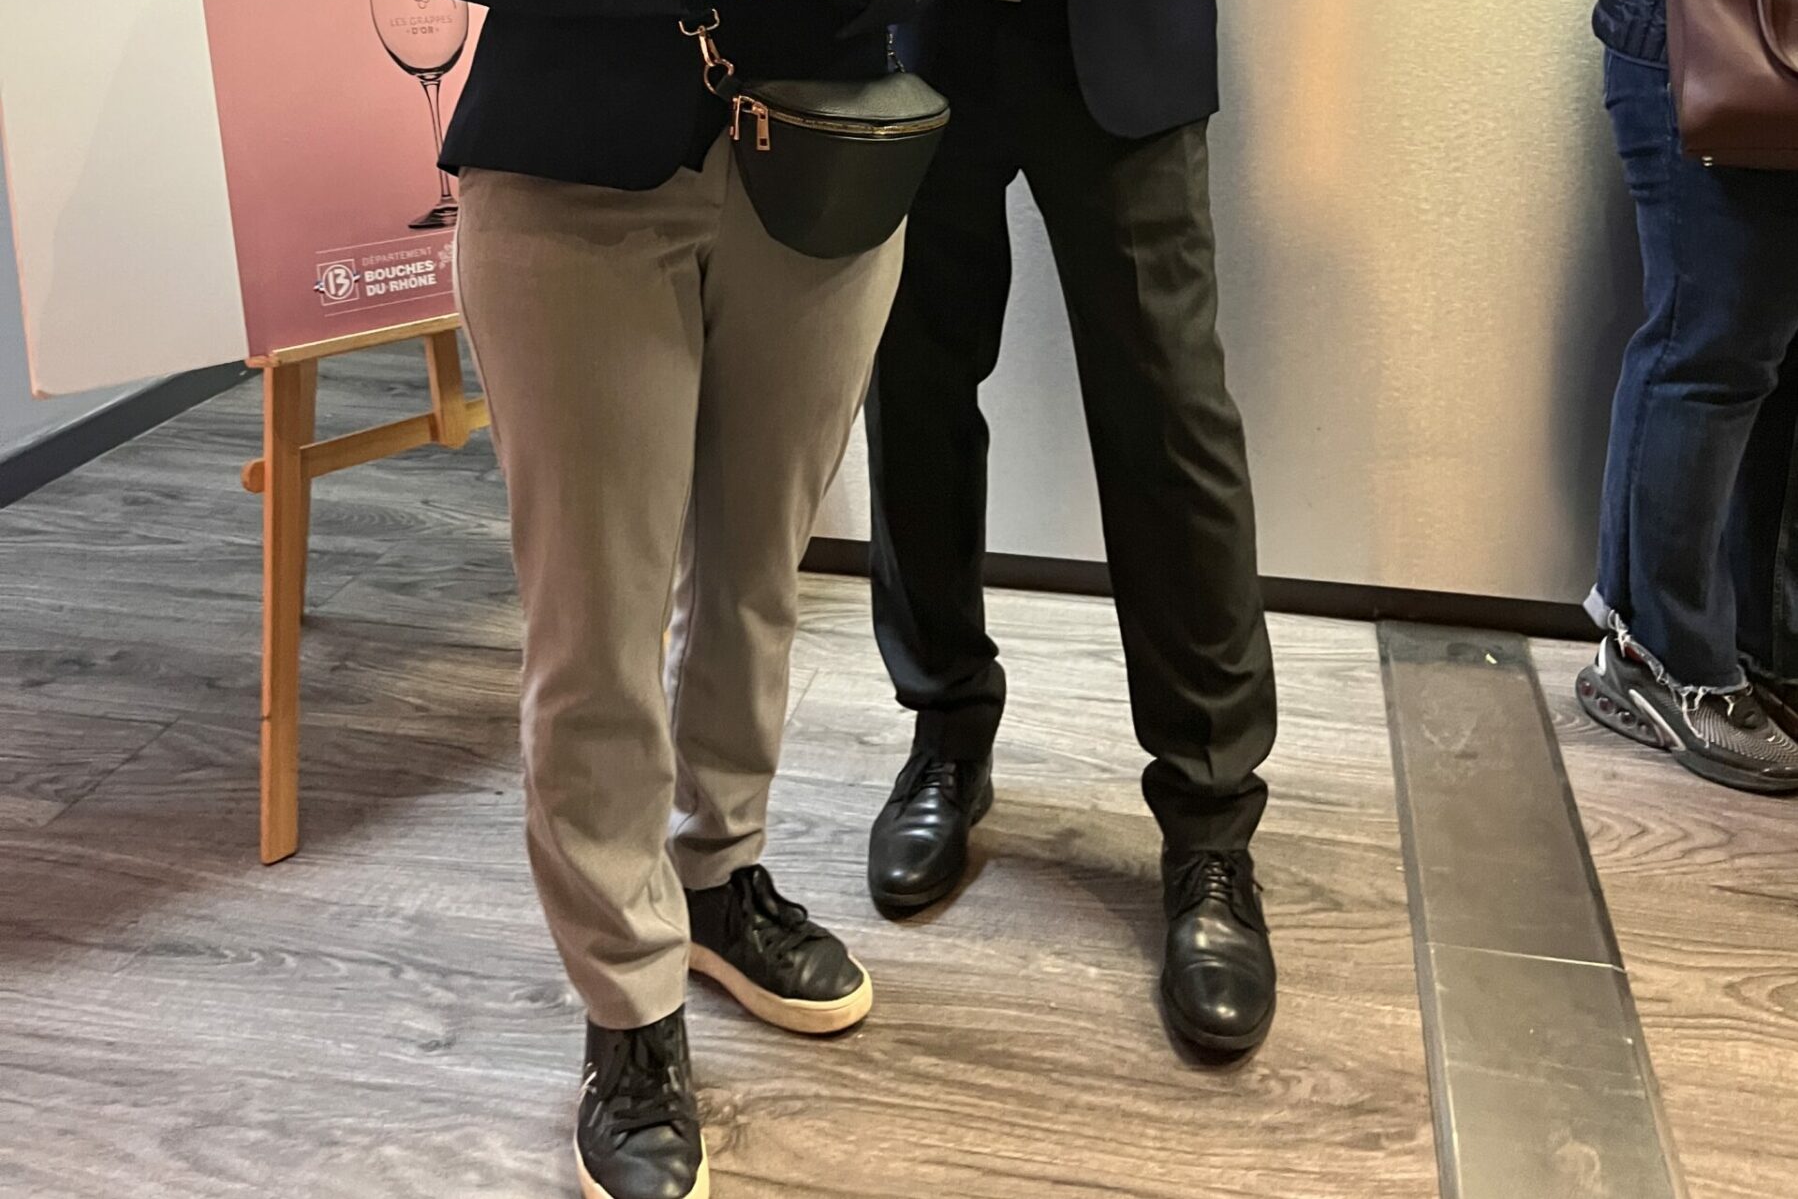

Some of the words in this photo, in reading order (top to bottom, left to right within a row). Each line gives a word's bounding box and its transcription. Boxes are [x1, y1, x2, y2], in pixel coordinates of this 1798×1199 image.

[362, 246, 432, 266] DÉPARTEMENT
[364, 260, 434, 282] BOUCHES
[366, 284, 385, 296] DU
[389, 274, 437, 292] RHÔNE
